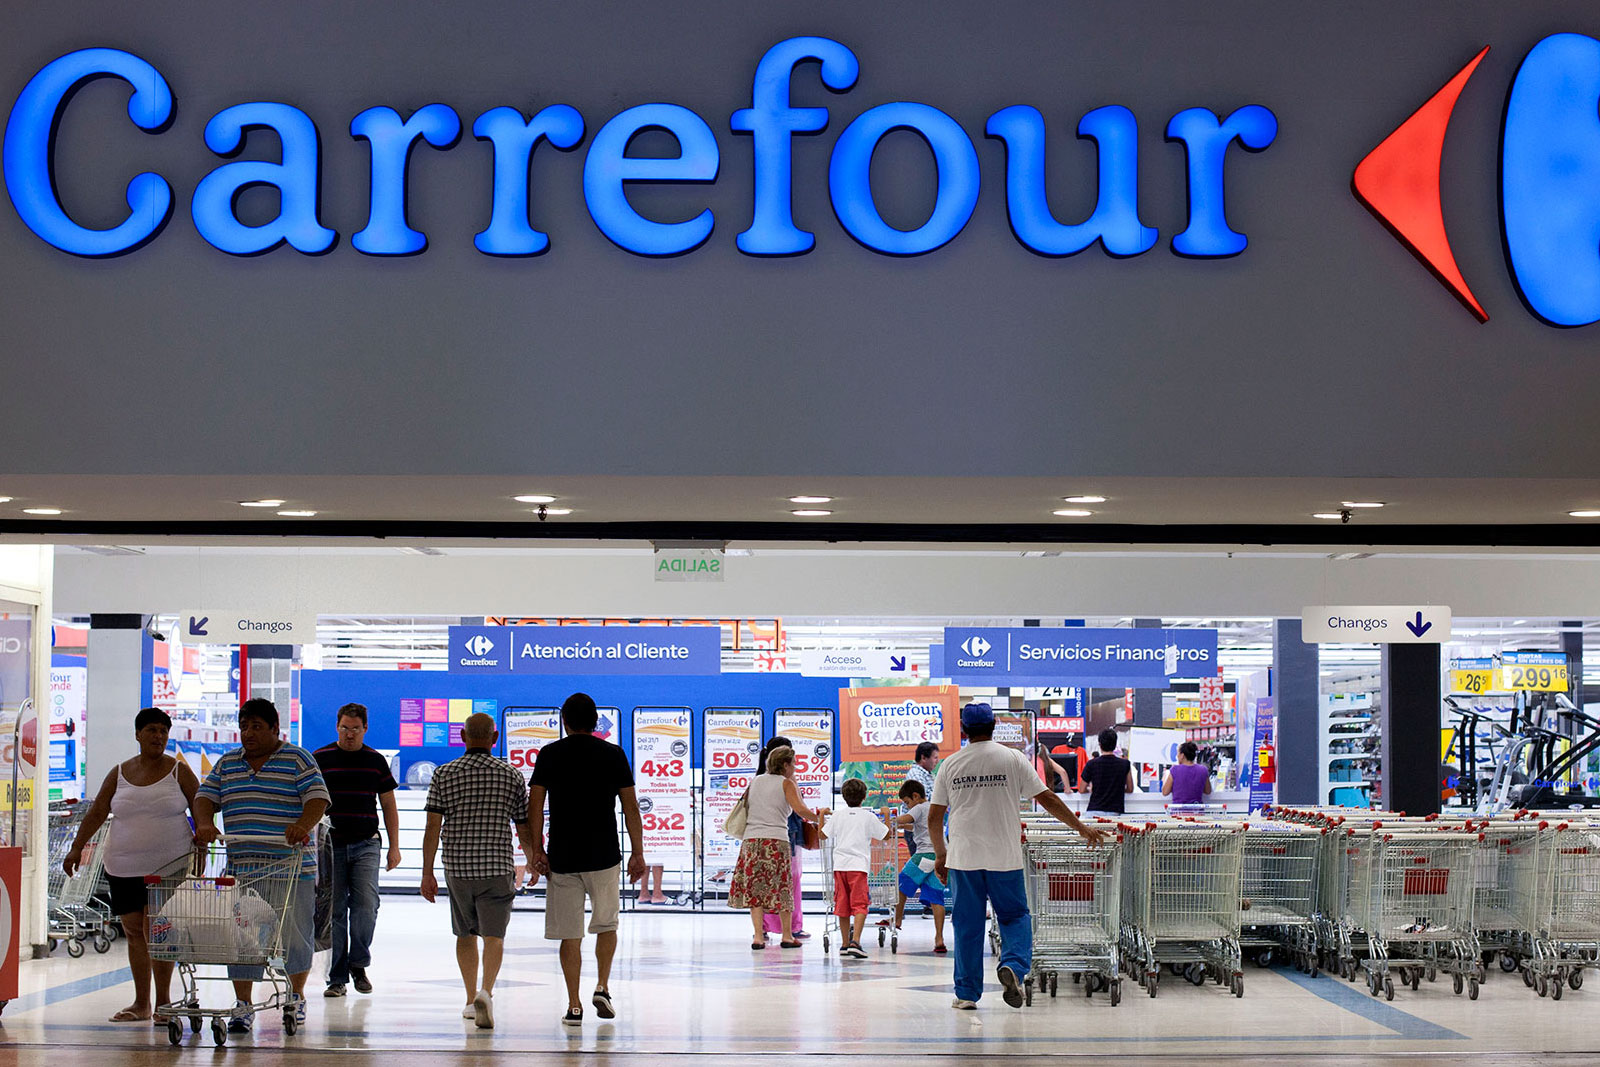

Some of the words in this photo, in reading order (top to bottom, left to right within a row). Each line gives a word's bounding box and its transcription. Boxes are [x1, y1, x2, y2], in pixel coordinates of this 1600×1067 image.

[3, 36, 1279, 256] Carrefour
[237, 619, 293, 634] Changos
[1327, 616, 1388, 632] Changos
[520, 640, 603, 664] Atención
[605, 643, 622, 664] al
[624, 642, 690, 664] Cliente
[1020, 643, 1102, 662] Servicios
[1105, 643, 1209, 662] Financeros
[460, 658, 499, 670] Carrefour
[823, 655, 862, 665] Acceso
[957, 658, 996, 670] Carrefour
[863, 702, 938, 717] Carrefour
[507, 719, 544, 728] Carrefour
[636, 717, 673, 725] Carrefour
[708, 718, 744, 727] Carrefour
[778, 719, 814, 728] Carrefour
[865, 719, 878, 729] te
[880, 718, 911, 729] lleva
[913, 719, 921, 728] a
[640, 759, 684, 778] 4x3
[883, 763, 913, 772] Deposit
[952, 776, 977, 785] CLEAN
[978, 774, 1007, 783] BAIRES
[6, 783, 31, 807] Rajas
[642, 813, 685, 831] 3x2
